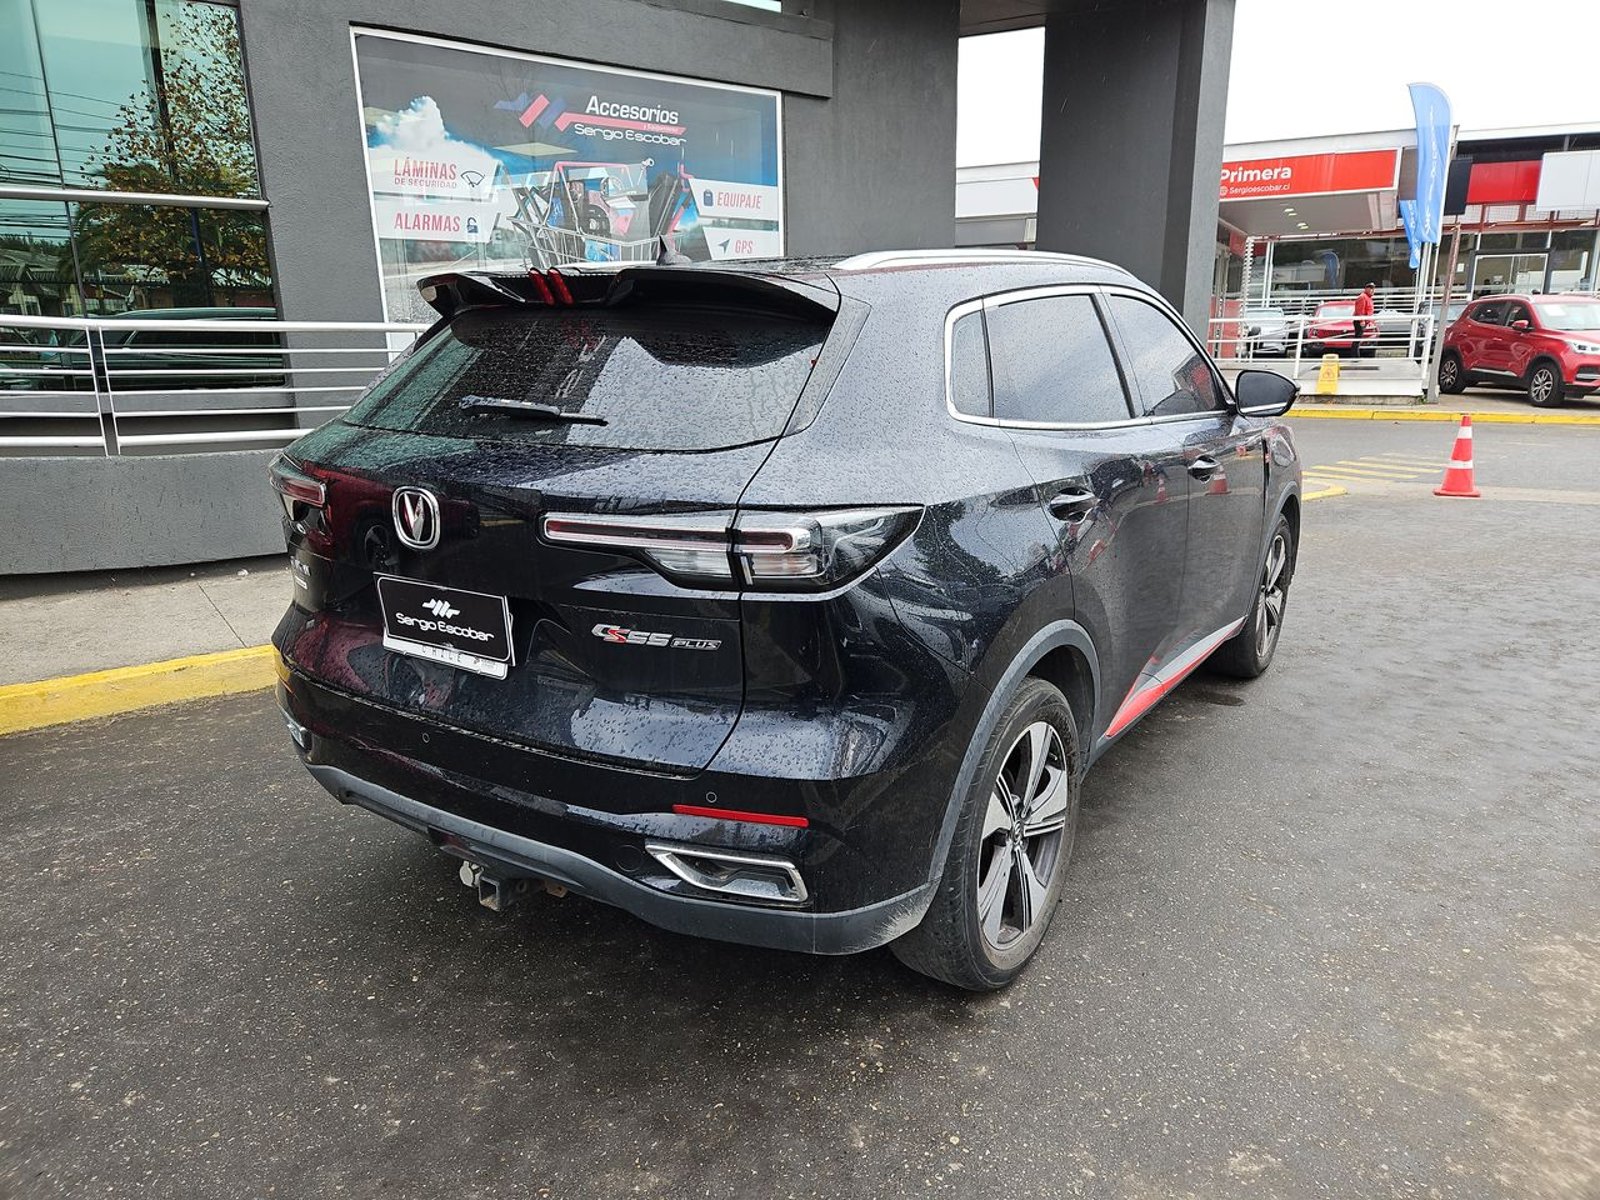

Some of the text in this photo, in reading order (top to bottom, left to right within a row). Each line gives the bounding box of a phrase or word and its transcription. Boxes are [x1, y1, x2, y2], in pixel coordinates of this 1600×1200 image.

[585, 95, 679, 125] Accesorios
[625, 129, 687, 146] Escobar
[394, 156, 457, 180] LÁMINAS
[1220, 166, 1292, 183] Primera
[394, 177, 457, 189] DE SEGURIDAD
[717, 191, 762, 209] EQUIPAJE
[394, 212, 461, 232] ALARMAS
[734, 239, 753, 254] GPS
[437, 620, 495, 642] Escobar
[670, 637, 722, 650] PLUS
